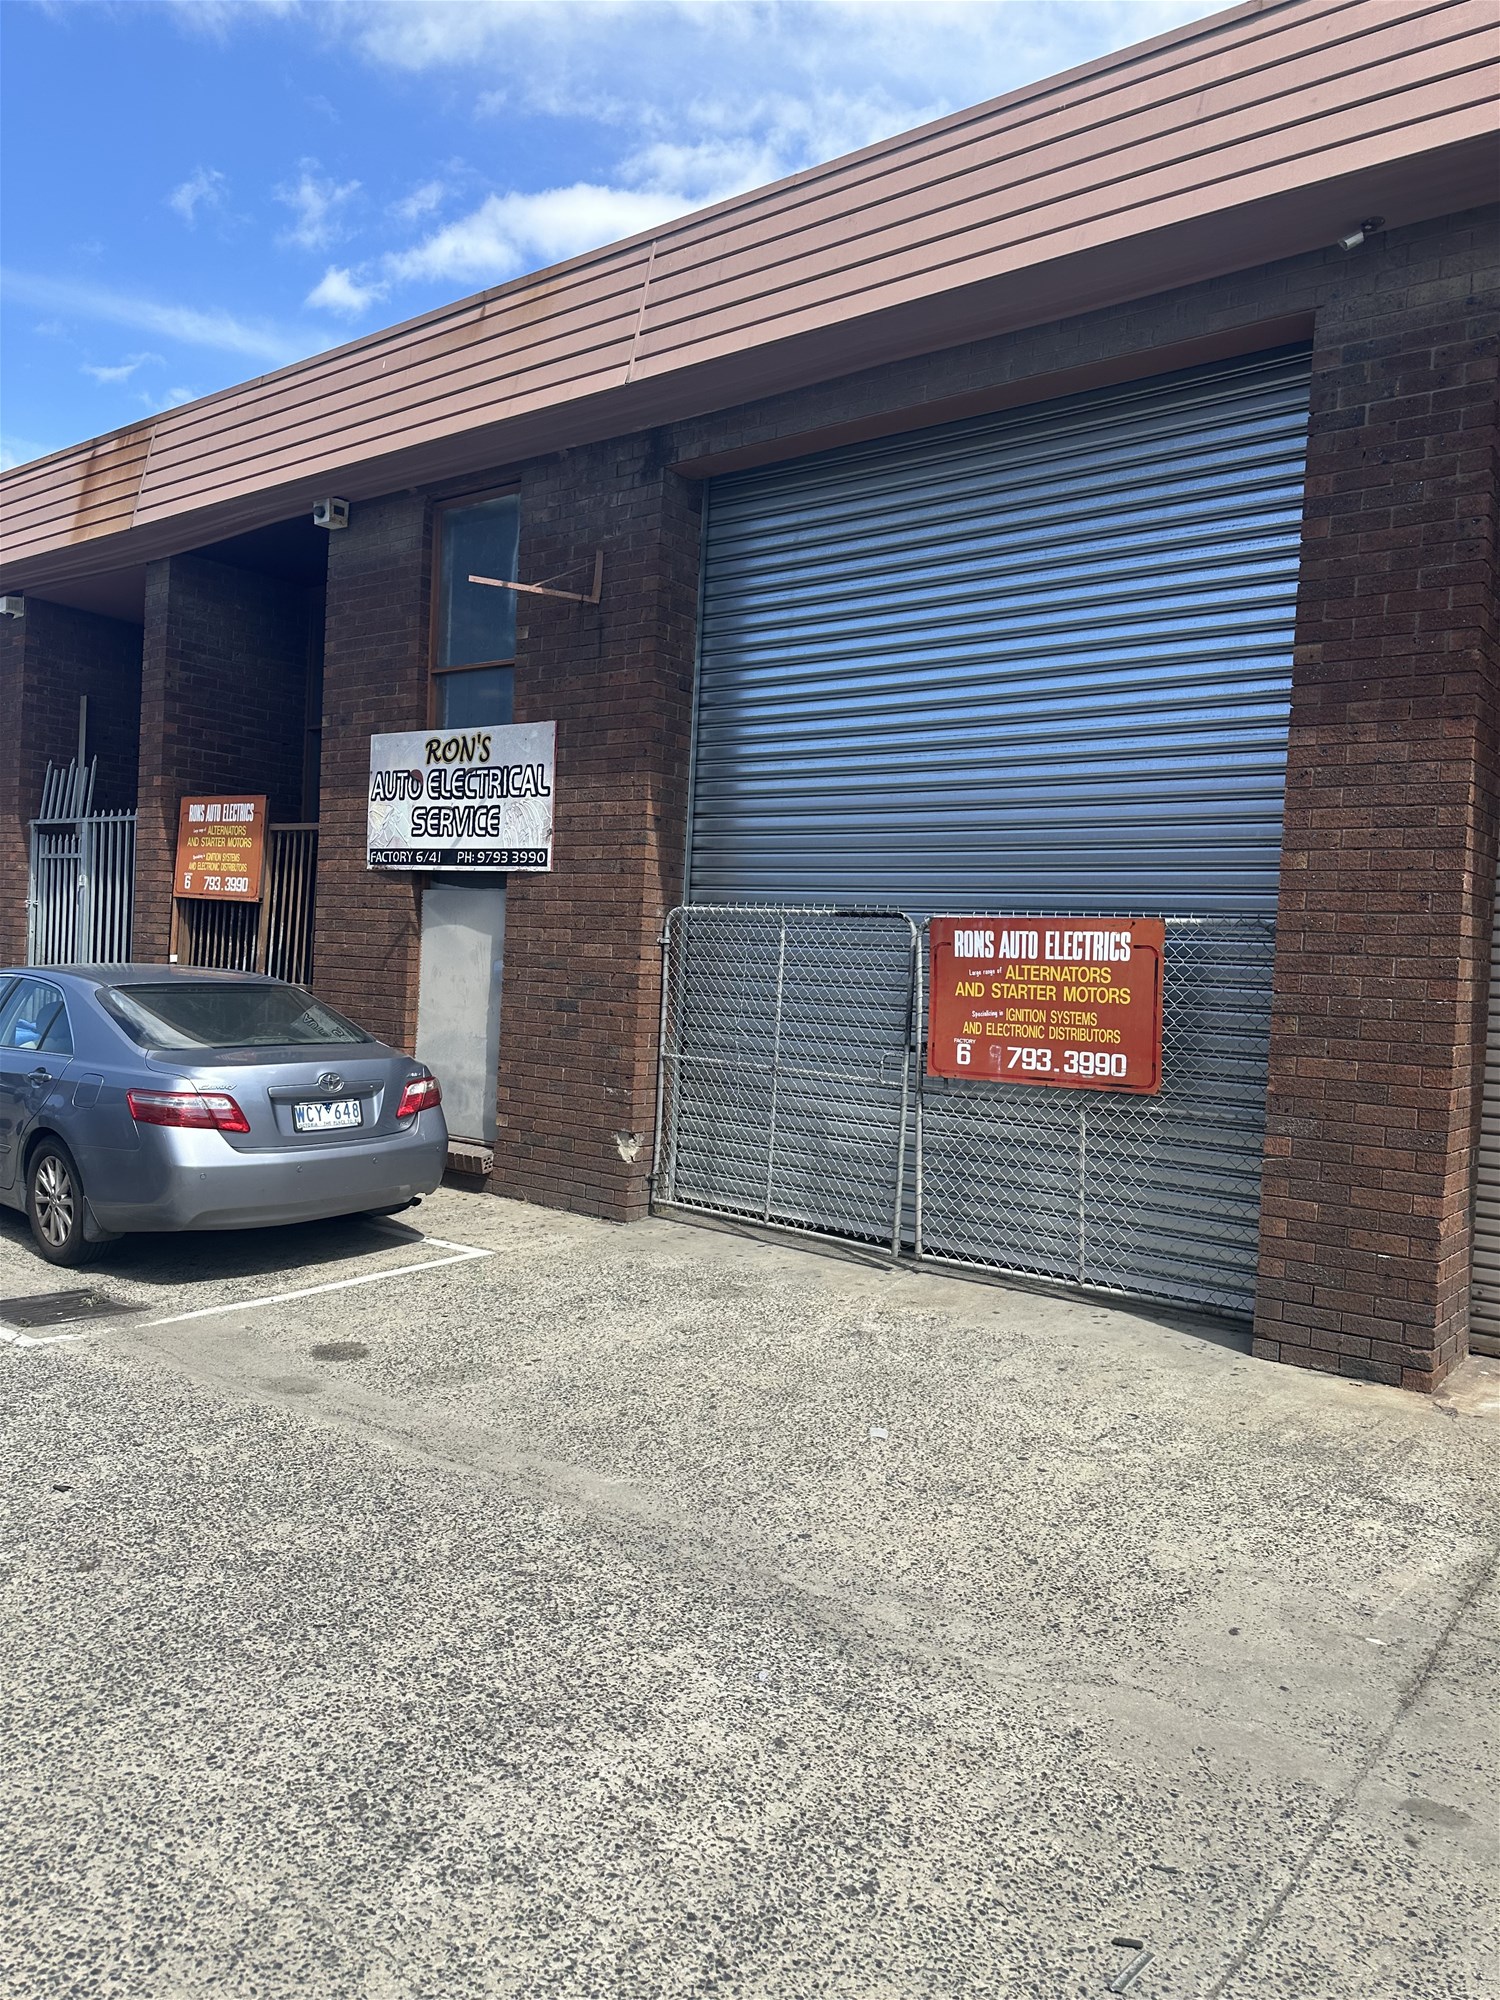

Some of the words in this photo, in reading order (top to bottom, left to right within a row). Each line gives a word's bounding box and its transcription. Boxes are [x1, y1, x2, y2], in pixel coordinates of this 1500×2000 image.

[425, 732, 492, 766] RON'S
[371, 769, 423, 800] AUTO
[427, 764, 550, 800] ELECTRICAL
[205, 804, 222, 822] AUTO
[222, 803, 255, 822] ELECTRICS
[411, 805, 500, 837] SERVICE
[207, 825, 247, 836] ALTERNATORS
[187, 837, 199, 847] AND
[200, 837, 226, 848] STARTER
[227, 837, 252, 848] MOTORS
[197, 862, 220, 871] ELECTRONIC
[222, 853, 240, 863] SYSTEMS
[370, 851, 413, 863] FACTORY
[415, 851, 441, 863] 6/41
[477, 851, 509, 863] 9793
[512, 851, 546, 863] 3990
[184, 875, 192, 889] 6
[954, 930, 995, 958] RONS
[999, 930, 1038, 959] AUTO
[1045, 931, 1132, 962] ELECTRICS
[1005, 965, 1112, 984] ALTERNATORS
[955, 982, 985, 998] AND
[991, 983, 1057, 1001] STARTER
[1064, 986, 1131, 1005] MOTORS
[1005, 1008, 1046, 1023] IGNITION
[1050, 1010, 1098, 1026] SYSTEMS
[962, 1021, 983, 1035] AND
[986, 1022, 1045, 1039] ELECTRONIC
[1049, 1026, 1121, 1044] DISTRIBUTORS
[956, 1043, 971, 1065] 6
[295, 1105, 322, 1123] WCY
[334, 1103, 359, 1120] 648
